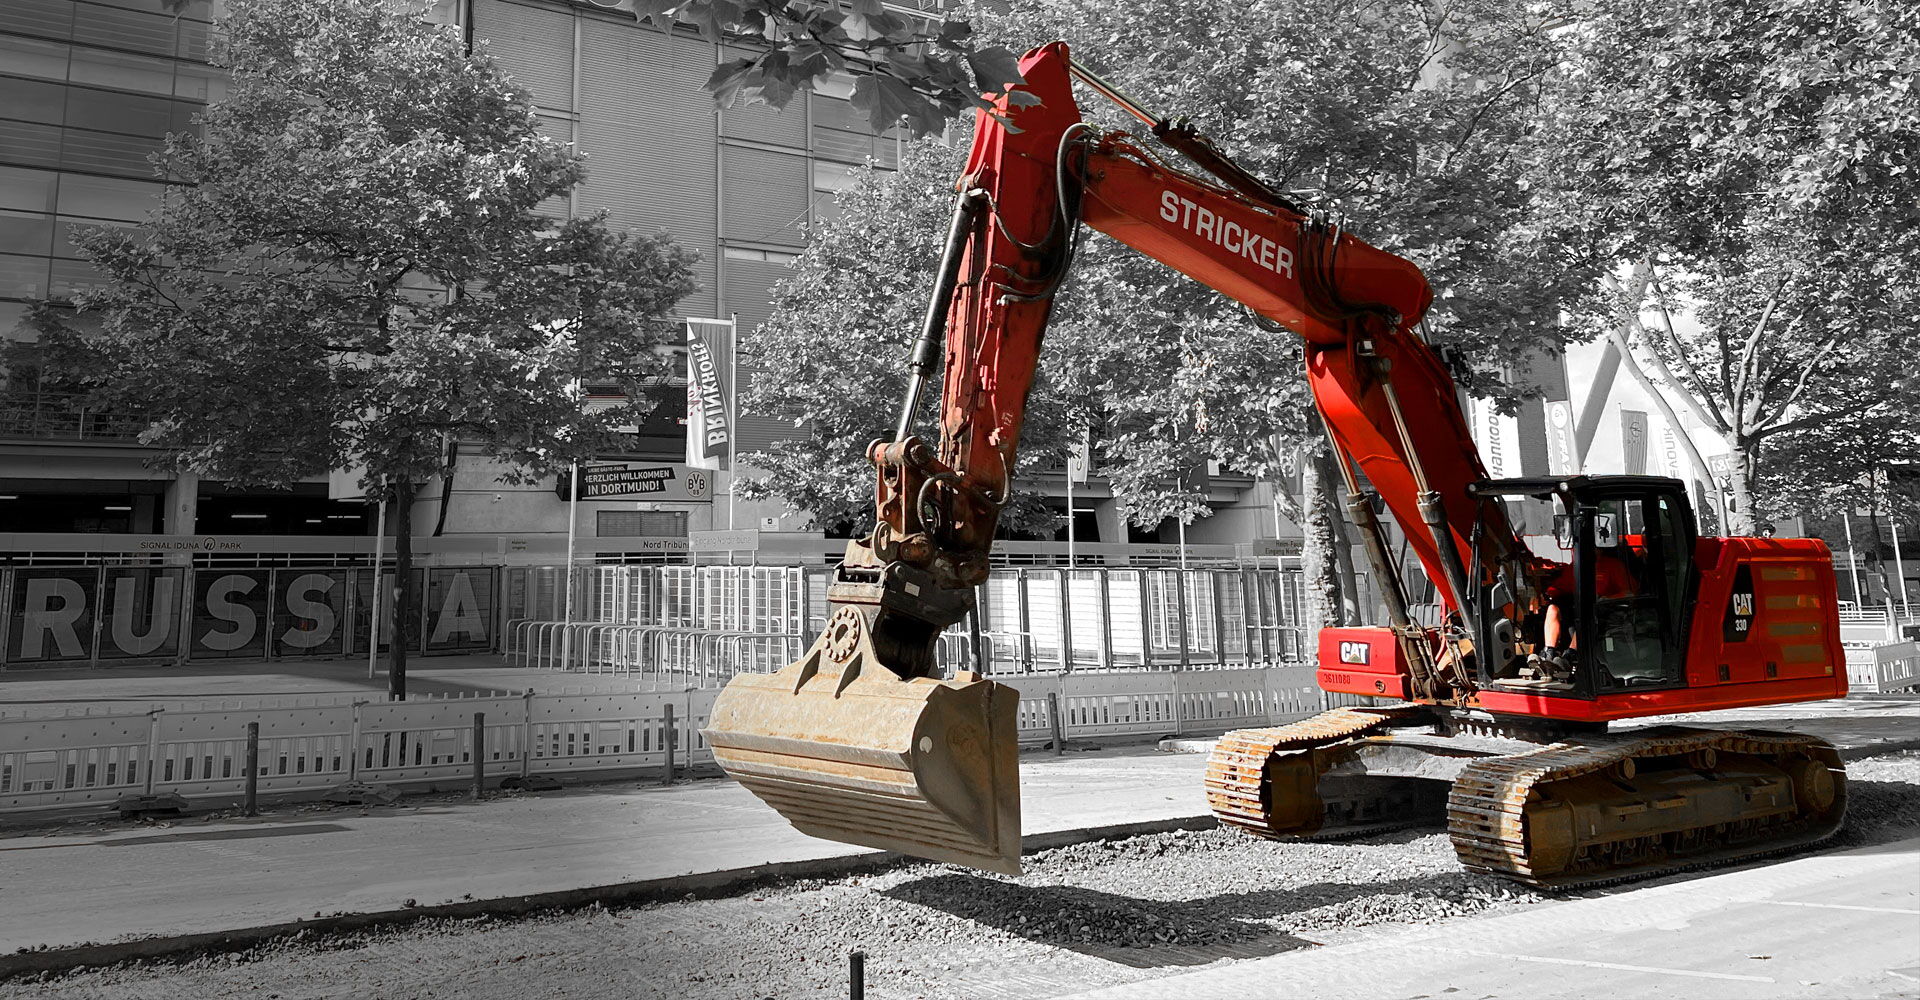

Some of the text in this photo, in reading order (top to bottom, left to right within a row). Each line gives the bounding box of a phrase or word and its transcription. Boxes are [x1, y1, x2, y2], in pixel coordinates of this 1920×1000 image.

[1160, 190, 1294, 280] STRICKER
[620, 469, 670, 481] WILLKOMMEN
[688, 473, 705, 490] BVB
[587, 480, 660, 496] IN DORTMUND!
[140, 541, 242, 550] SIGNAL IDUNA PARK
[643, 540, 661, 549] Nord
[1732, 593, 1753, 616] CAT
[1735, 619, 1747, 632] 330
[1341, 642, 1368, 664] CAT
